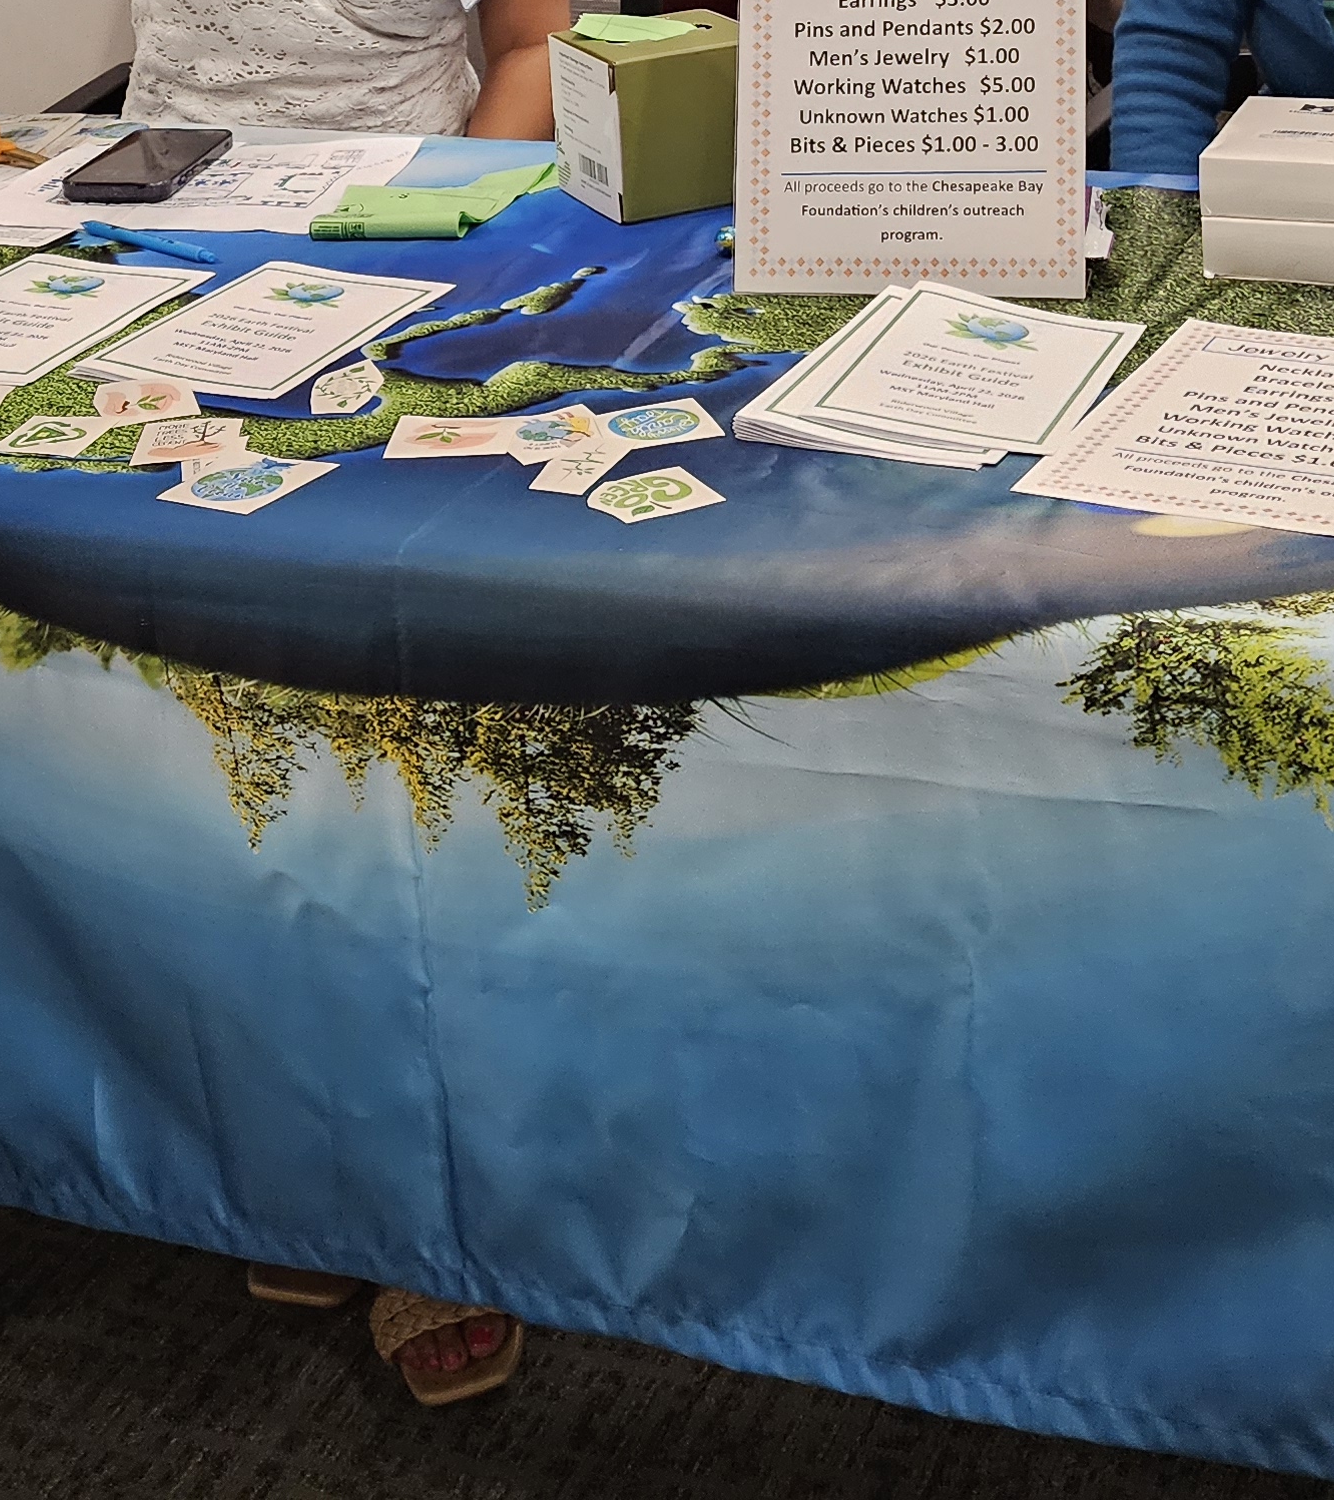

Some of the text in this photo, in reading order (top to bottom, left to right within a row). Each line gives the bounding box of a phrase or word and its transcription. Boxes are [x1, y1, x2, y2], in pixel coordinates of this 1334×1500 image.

[794, 16, 1035, 38] Pins and Pendants $2.00
[874, 47, 950, 69] Jewelry
[964, 46, 1020, 67] $1.00
[793, 74, 1035, 99] Working Watches $5.00
[799, 104, 1029, 126] Unknown Watches $1.00
[790, 136, 826, 154] Bits
[832, 136, 848, 153] &
[854, 136, 915, 153] Pieces
[921, 133, 977, 155] $1.00
[995, 135, 1039, 152] 3.00
[783, 179, 1044, 195] All proceeds go to the Chesapeake Bay
[963, 203, 1025, 216] outreach
[881, 231, 943, 243] program.
[902, 360, 963, 378] Exhibit
[1243, 386, 1333, 403] Earrings
[1189, 404, 1259, 418] Men's
[1163, 412, 1259, 432] Working
